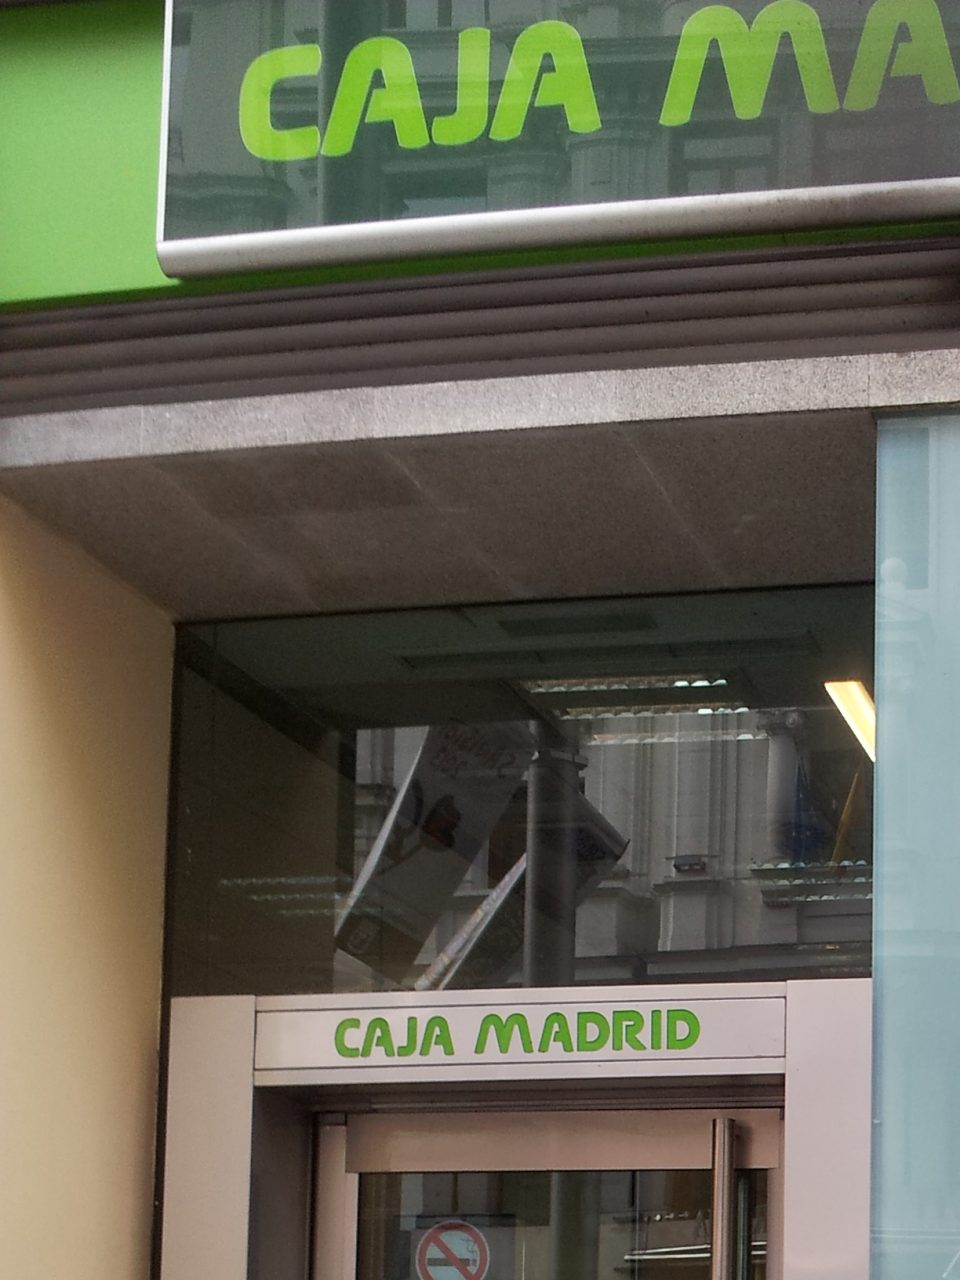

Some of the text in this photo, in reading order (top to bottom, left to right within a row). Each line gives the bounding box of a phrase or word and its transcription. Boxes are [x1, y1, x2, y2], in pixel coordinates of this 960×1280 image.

[239, 20, 602, 162] CAJA
[334, 1009, 701, 1058] CAJA MADRID
